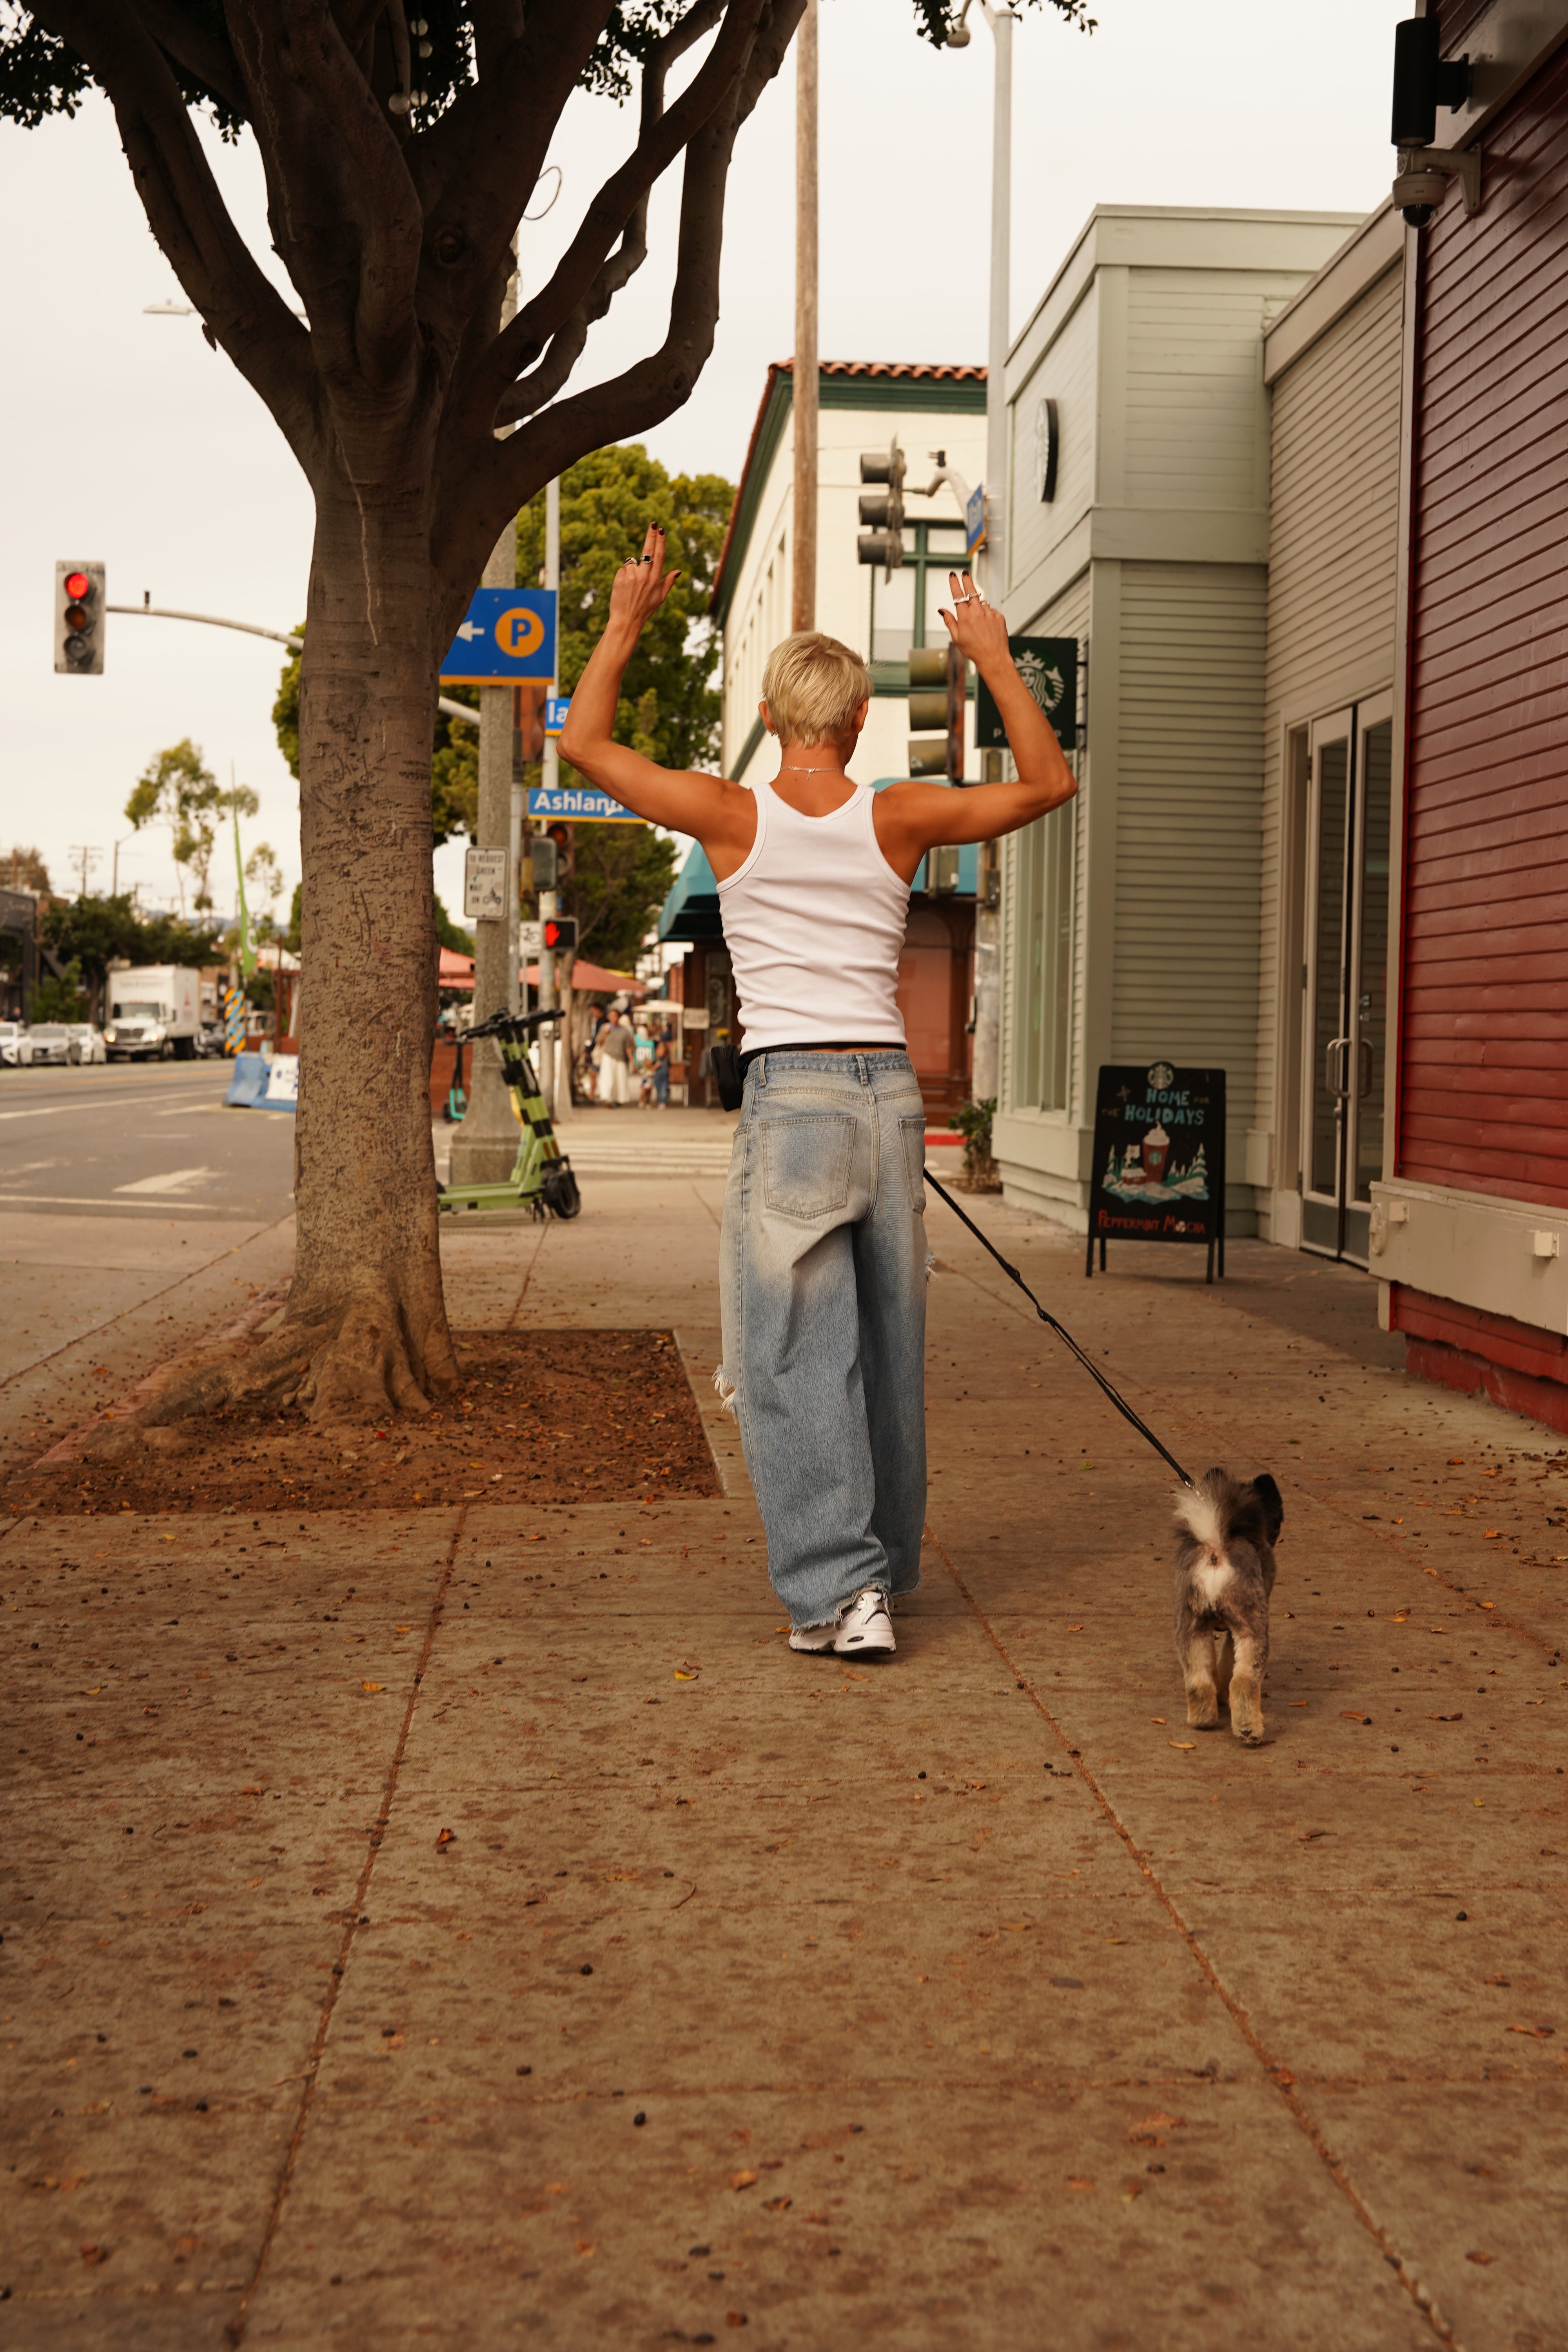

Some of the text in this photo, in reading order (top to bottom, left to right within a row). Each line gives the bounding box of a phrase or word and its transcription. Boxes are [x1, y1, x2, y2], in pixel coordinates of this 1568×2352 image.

[511, 618, 532, 646] P
[1146, 1088, 1190, 1106] HOME
[1124, 1104, 1205, 1125] HOLIDAYS
